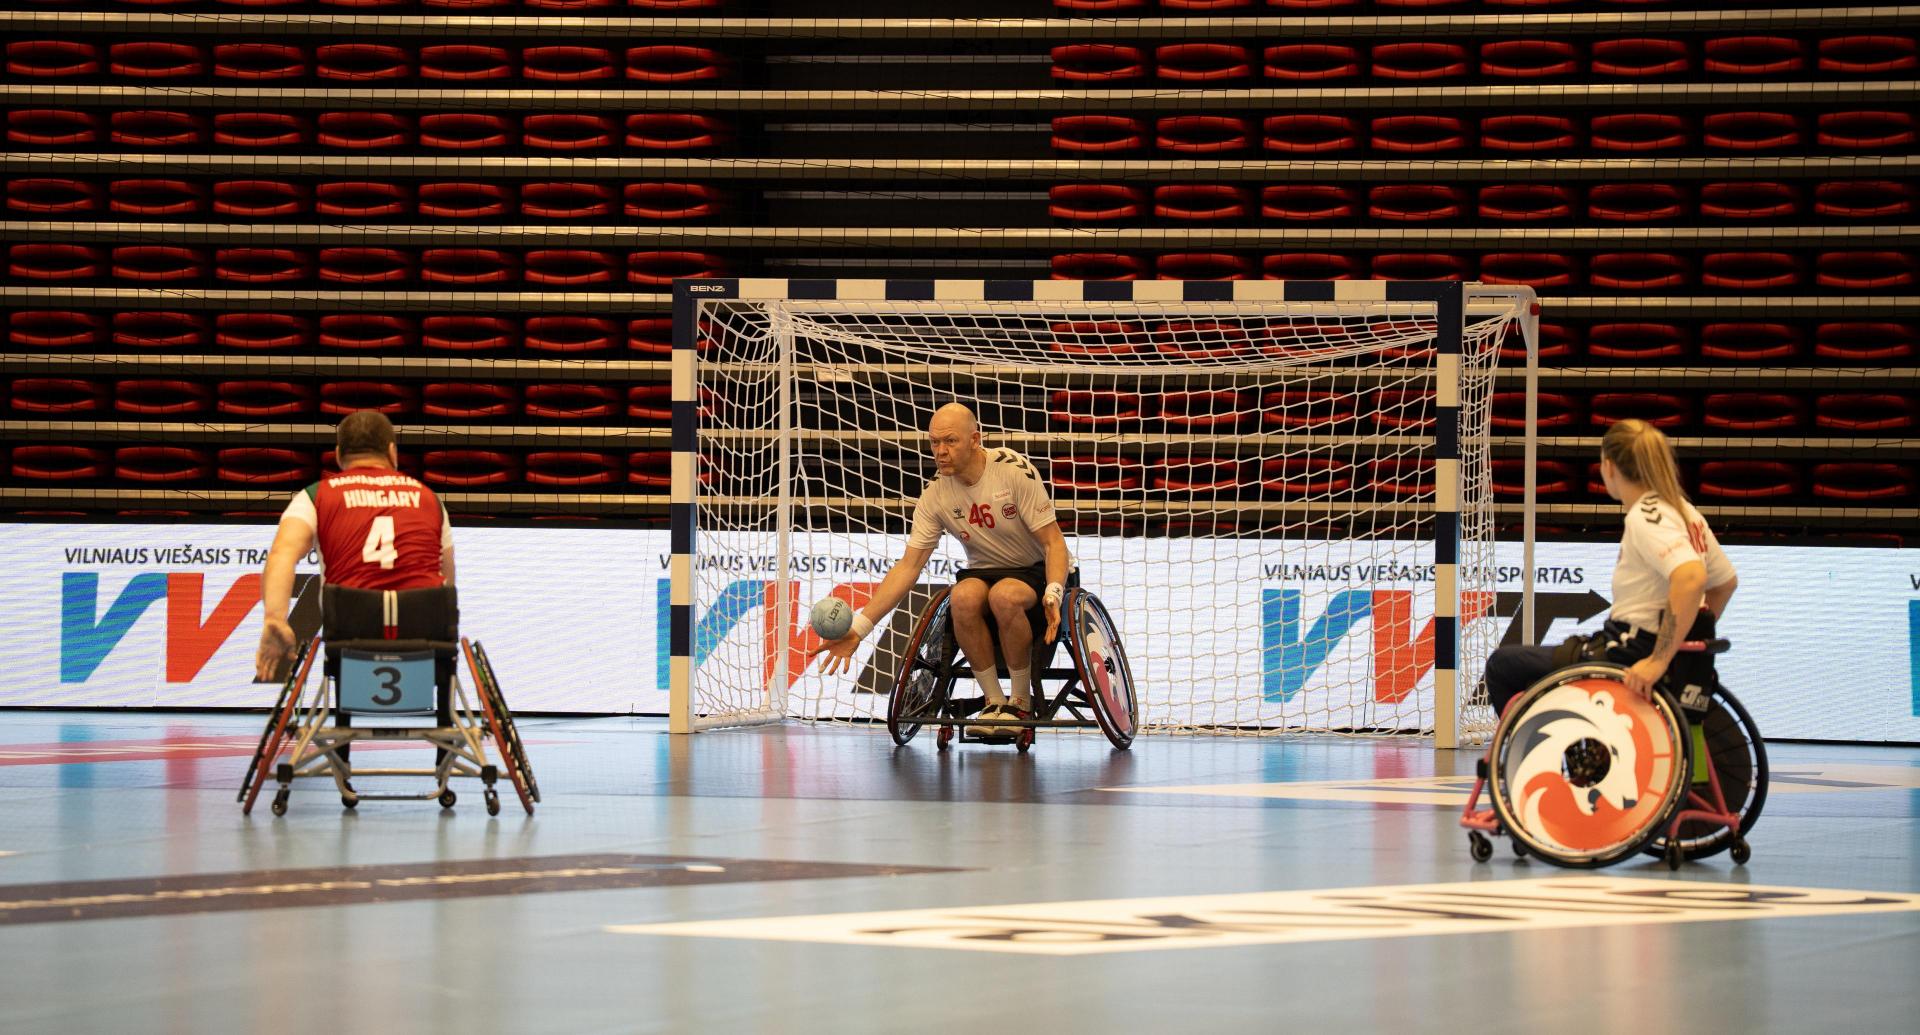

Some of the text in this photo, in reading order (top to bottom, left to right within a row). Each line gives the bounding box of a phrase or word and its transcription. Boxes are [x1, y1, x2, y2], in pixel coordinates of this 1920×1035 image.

[343, 489, 421, 509] HUNGARY
[969, 502, 996, 529] 46
[65, 548, 148, 565] VILNIAUS
[154, 544, 230, 565] VIEŠASIS
[362, 515, 398, 570] 4
[1264, 564, 1351, 581] VILNIAUS
[371, 666, 402, 706] 3
